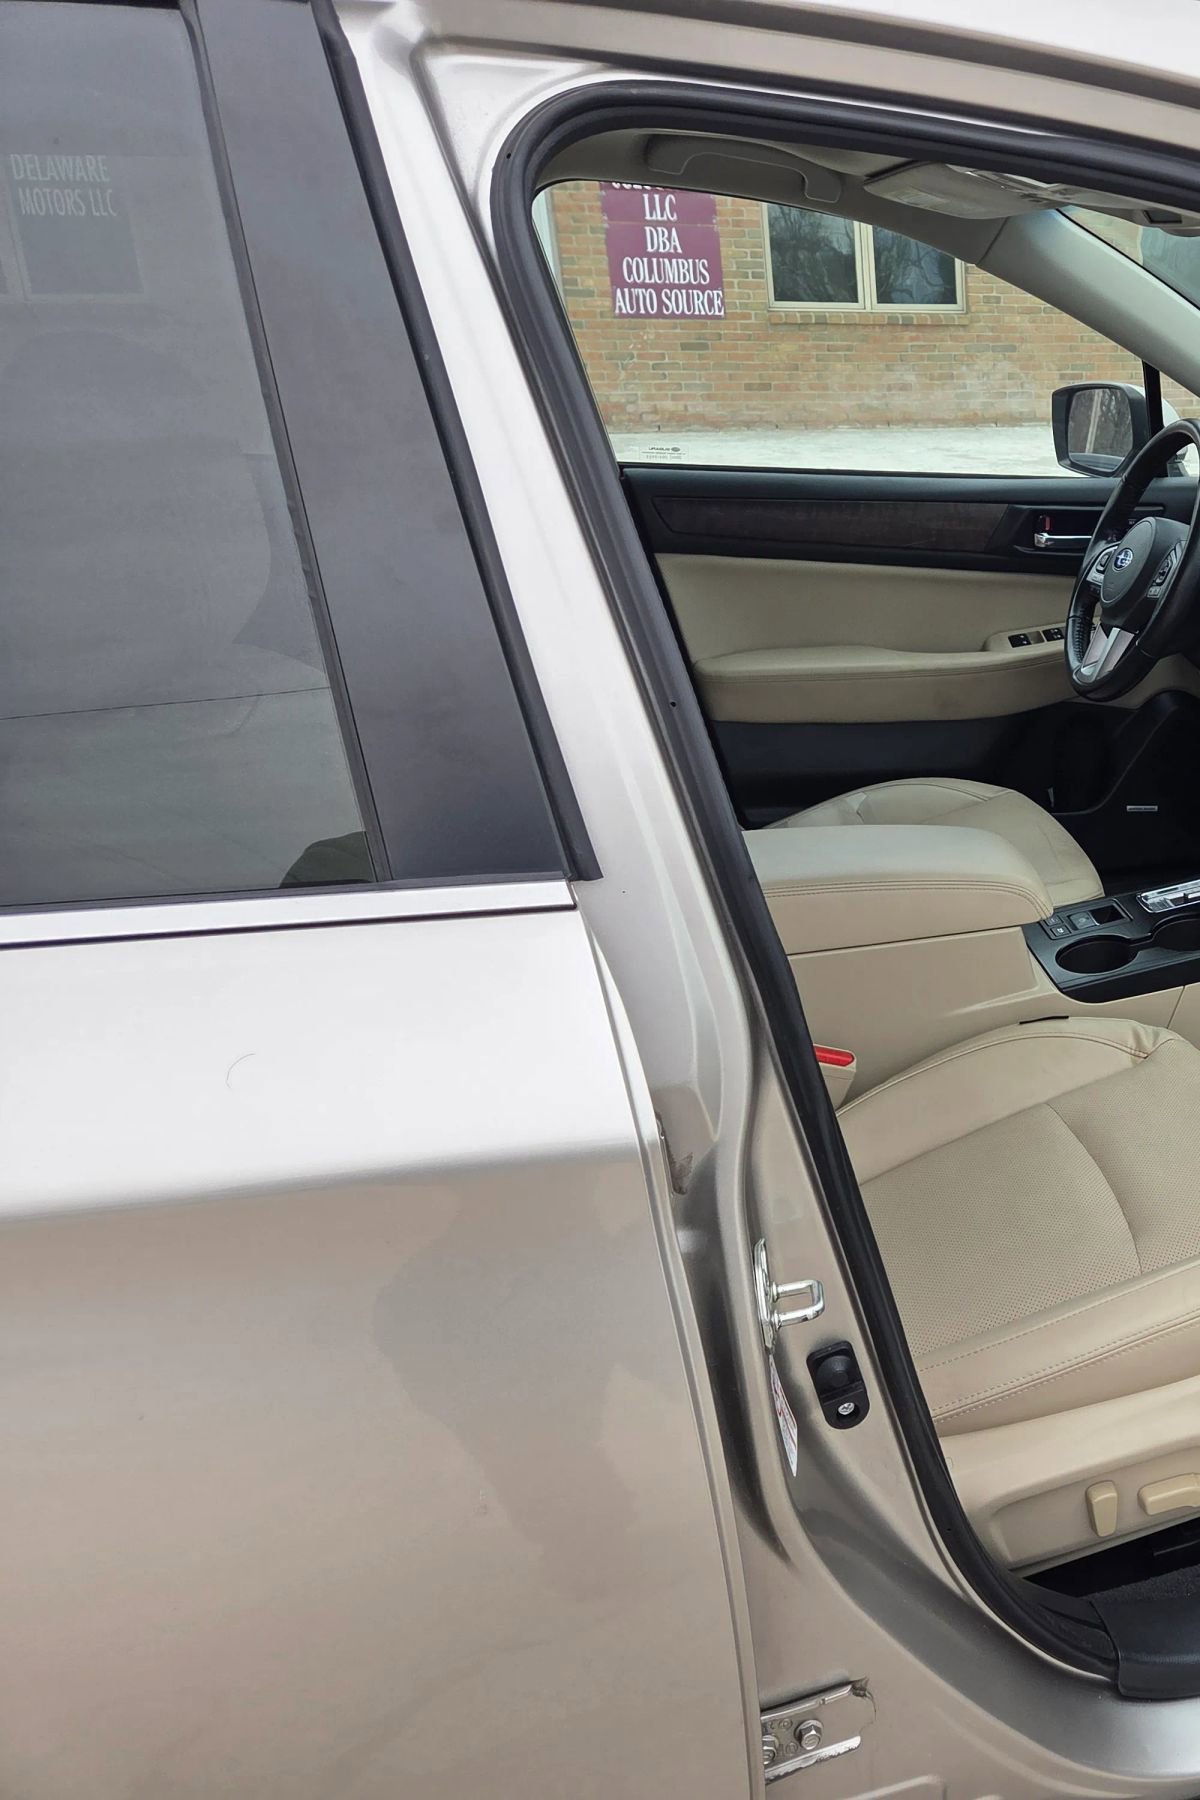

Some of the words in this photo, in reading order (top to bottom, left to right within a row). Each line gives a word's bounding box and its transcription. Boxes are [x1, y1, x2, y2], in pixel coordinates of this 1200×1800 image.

[8, 153, 110, 182] DELAWARE
[19, 187, 86, 216] MOTORS
[88, 187, 119, 217] LLC
[642, 193, 678, 221] LLC
[644, 226, 683, 254] DBA
[622, 256, 710, 285] COLUMBUS
[615, 287, 658, 315] AUTO
[661, 288, 725, 316] SOURCE
